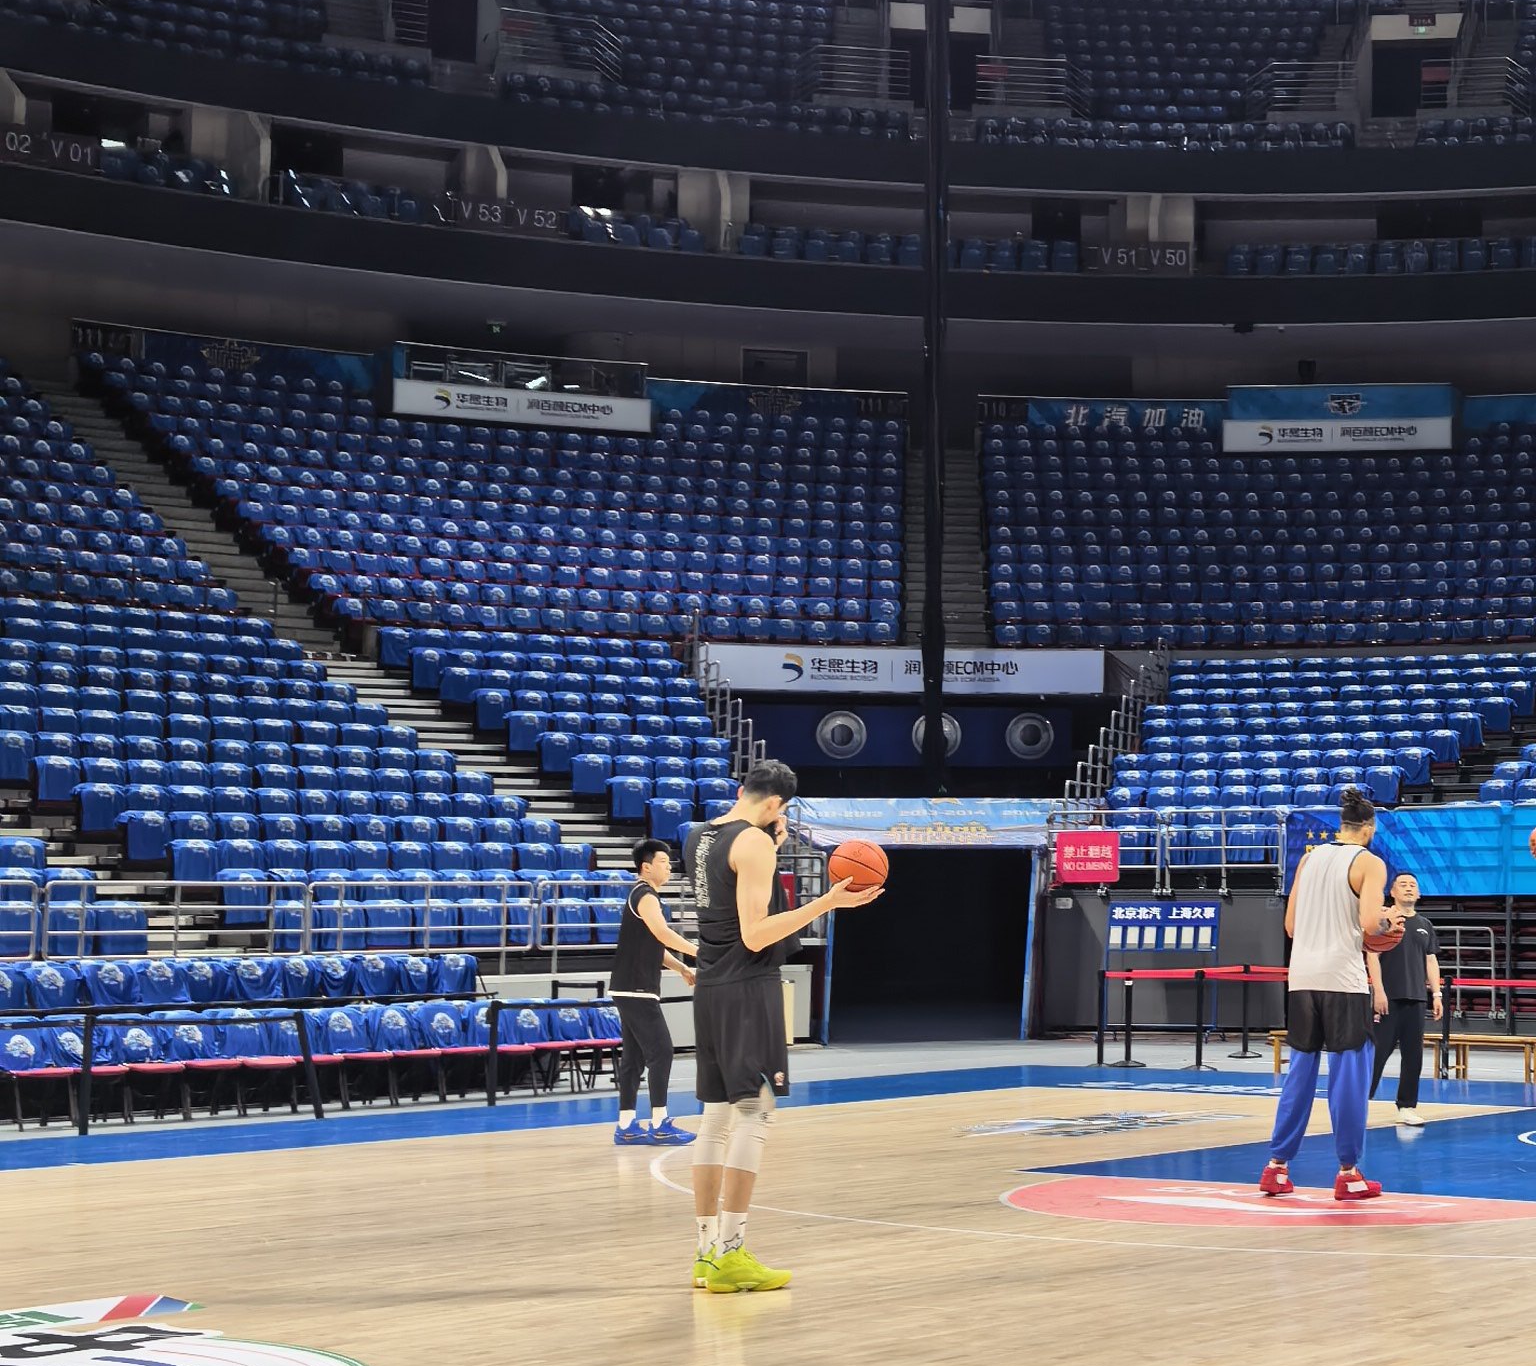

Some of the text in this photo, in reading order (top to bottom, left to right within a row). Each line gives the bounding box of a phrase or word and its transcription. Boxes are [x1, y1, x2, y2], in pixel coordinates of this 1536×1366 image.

[811, 657, 879, 674] 华熙生物
[1112, 906, 1216, 920] 北京北汽 上海久事
